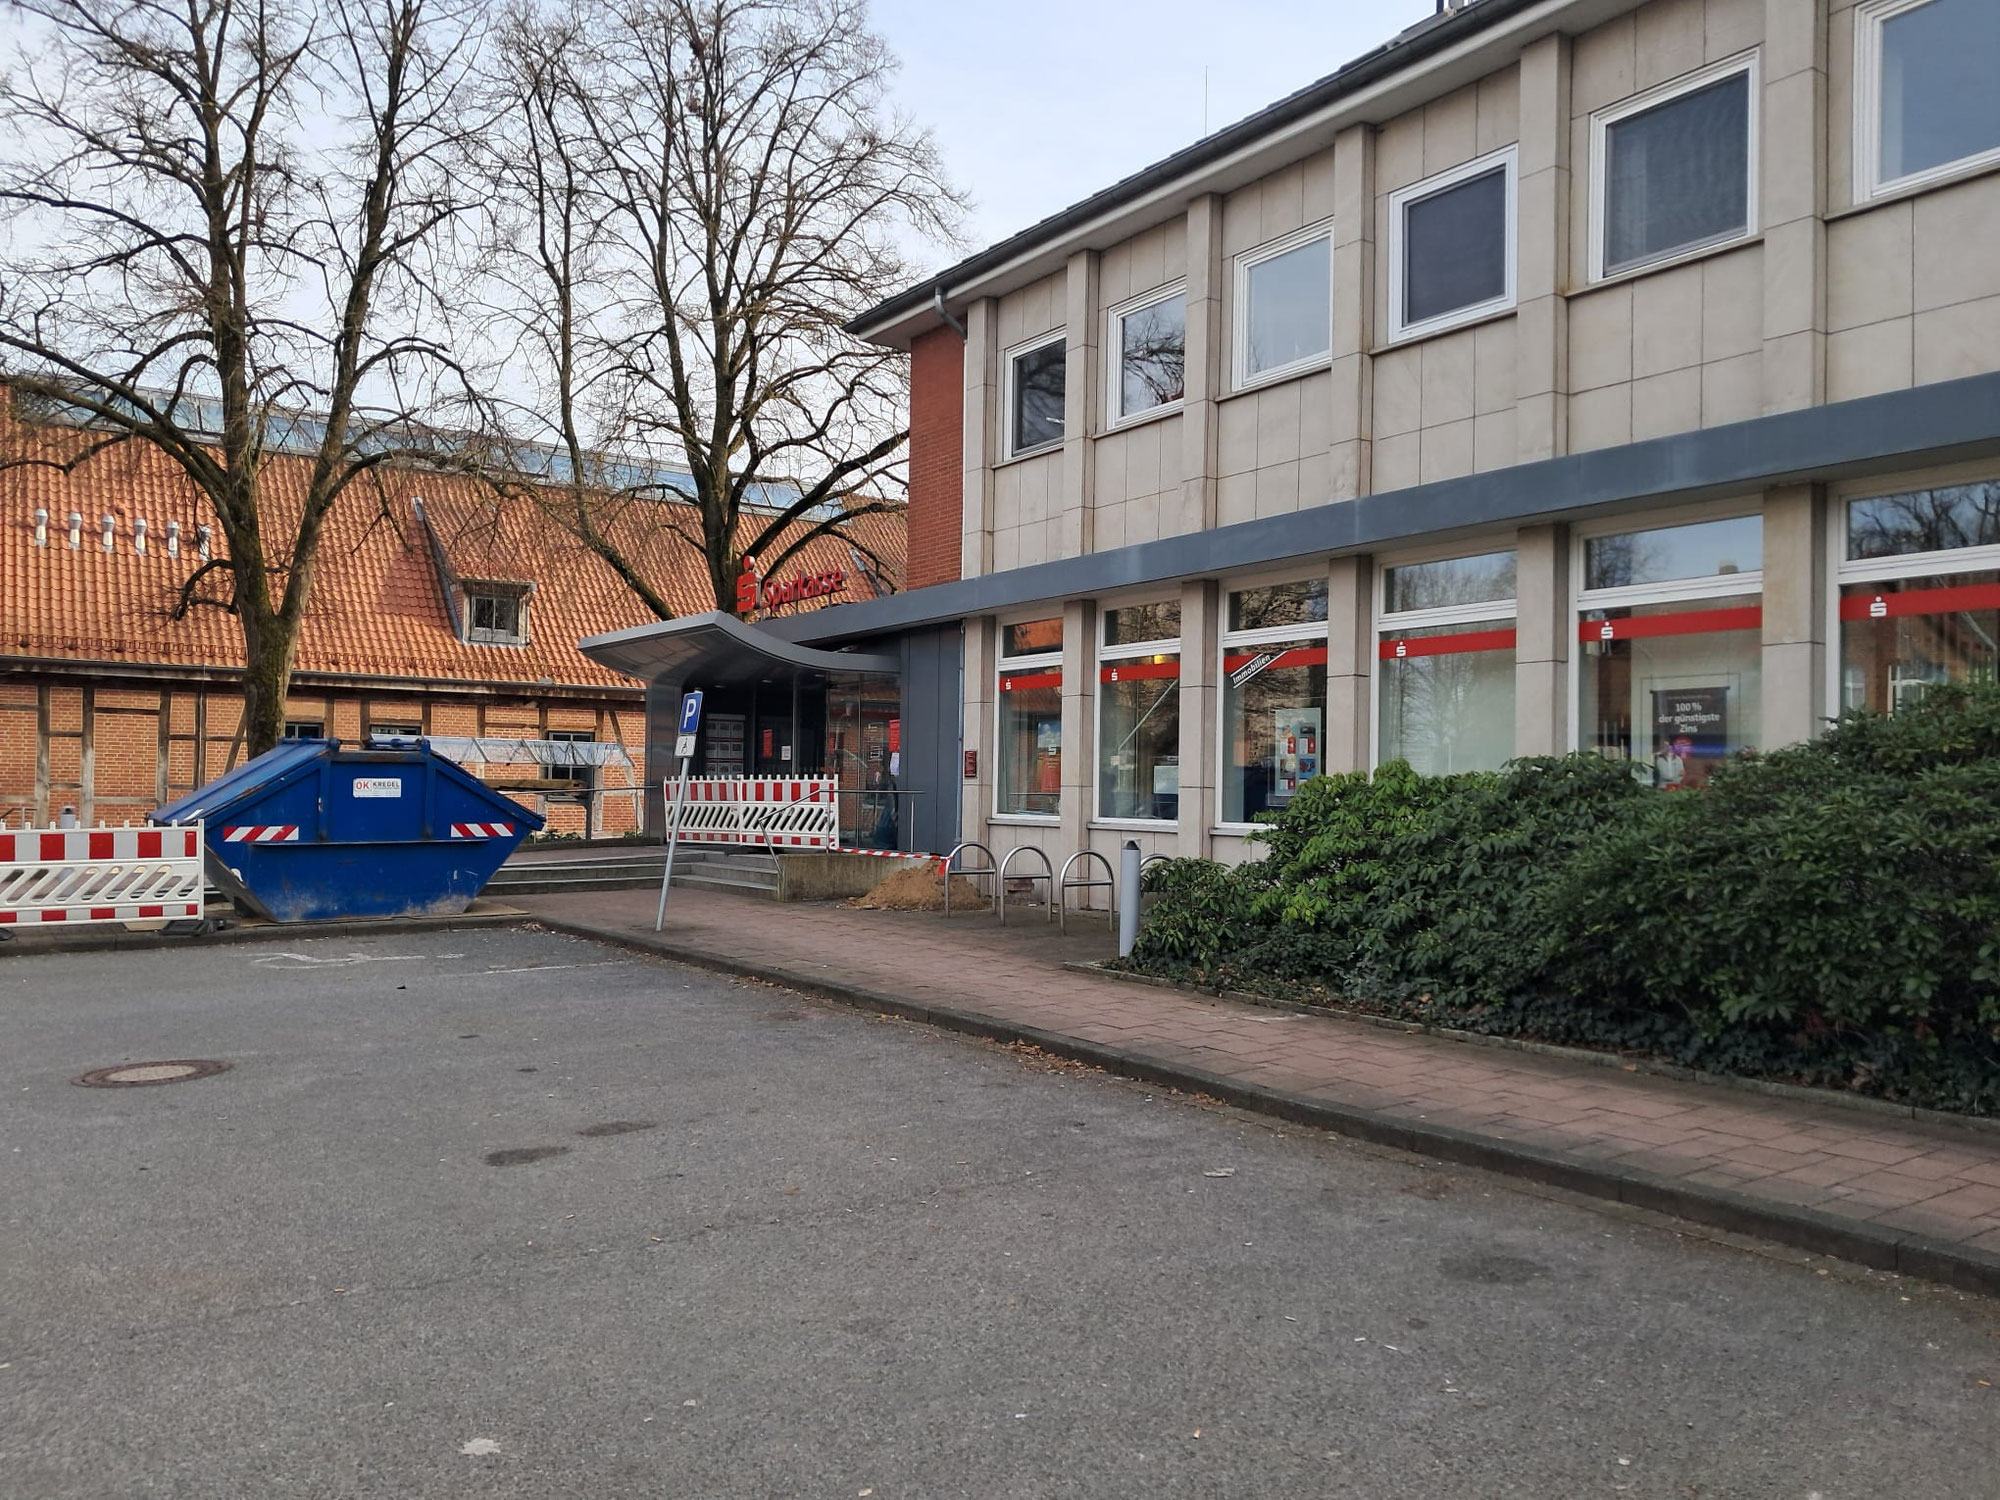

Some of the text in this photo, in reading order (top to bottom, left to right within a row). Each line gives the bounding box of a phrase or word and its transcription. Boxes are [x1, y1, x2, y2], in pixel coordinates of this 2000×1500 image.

[761, 568, 846, 612] Sparkasse
[1232, 654, 1271, 684] Immobilien
[683, 698, 697, 728] P
[1658, 712, 1720, 724] der günstigste
[1679, 724, 1698, 733] Zins
[356, 781, 370, 790] OK
